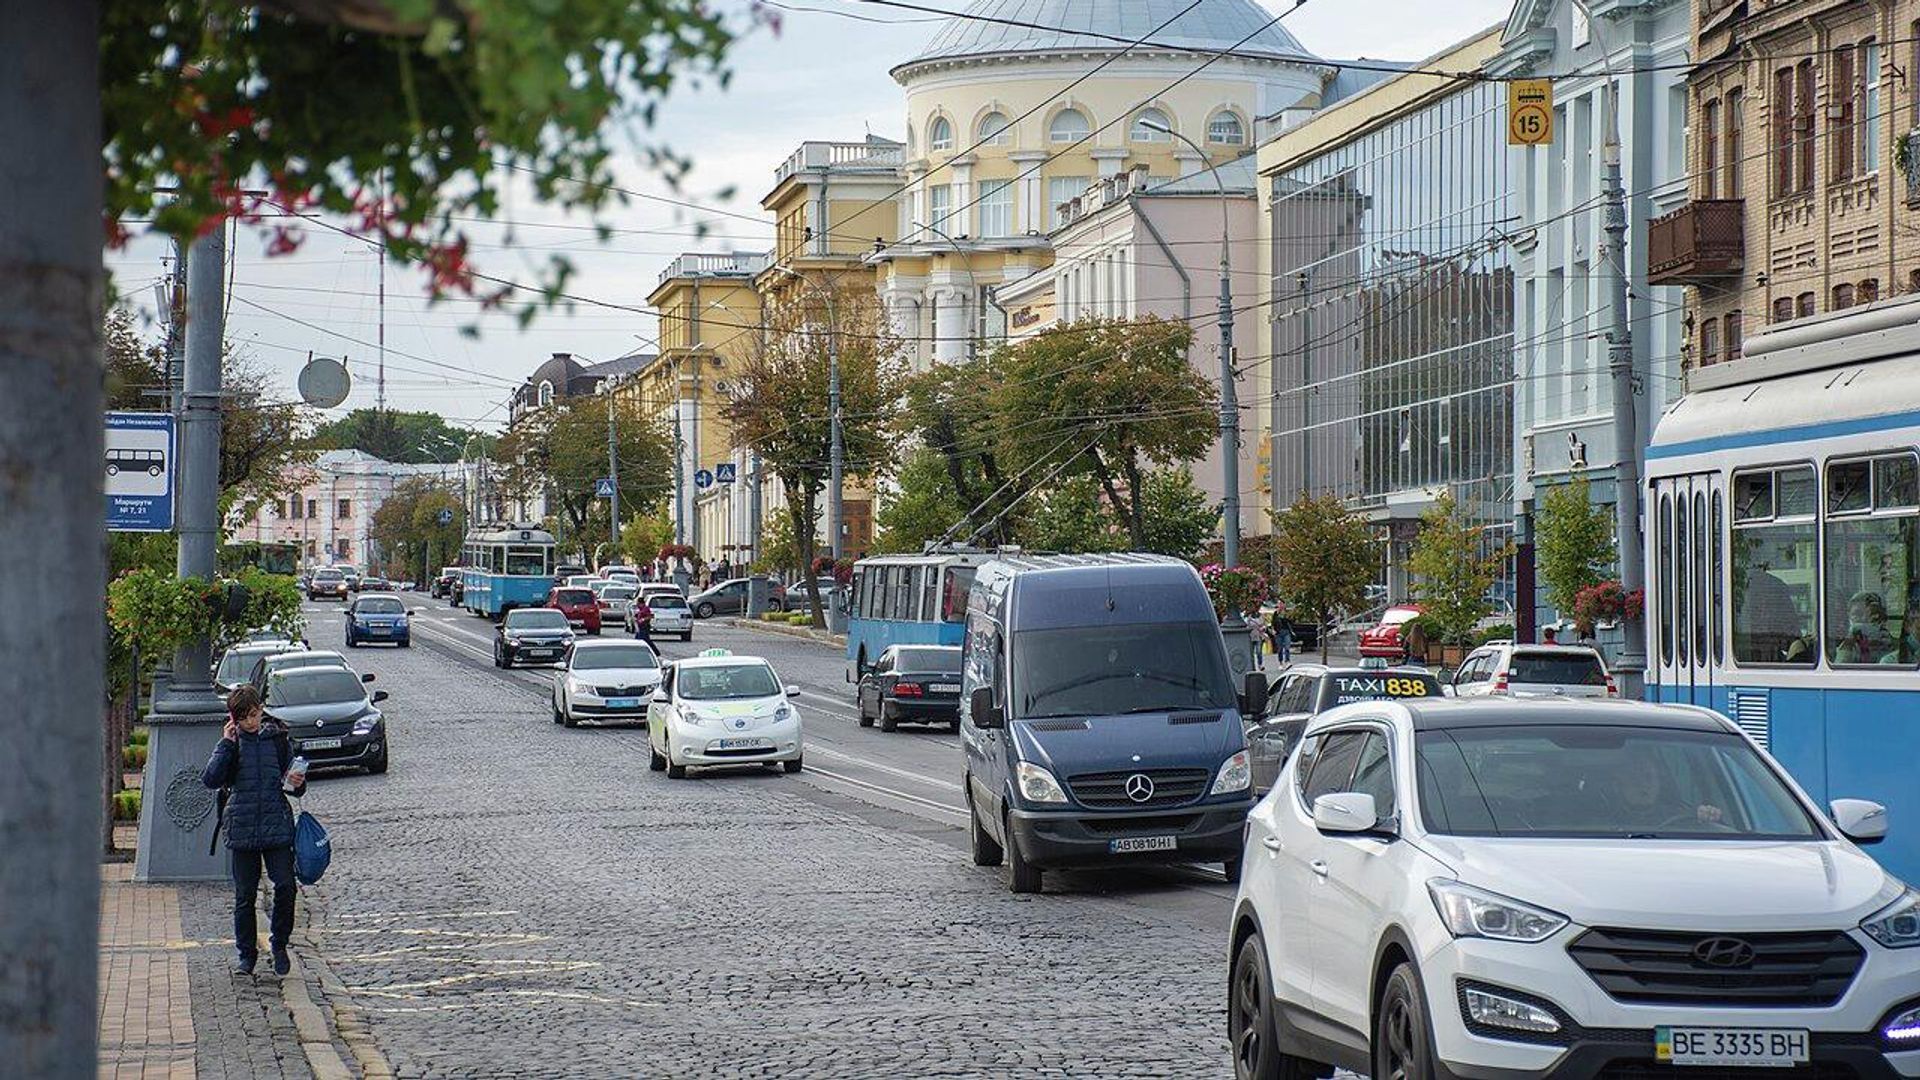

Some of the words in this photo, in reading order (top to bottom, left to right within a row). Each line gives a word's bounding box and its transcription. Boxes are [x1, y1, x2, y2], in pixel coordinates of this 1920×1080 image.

[1519, 115, 1540, 134] 15
[114, 498, 153, 507] Маршрути
[1117, 840, 1131, 850] AB
[1673, 1032, 1706, 1055] BE
[1712, 1033, 1764, 1055] 3335
[1771, 1034, 1804, 1056] BH
